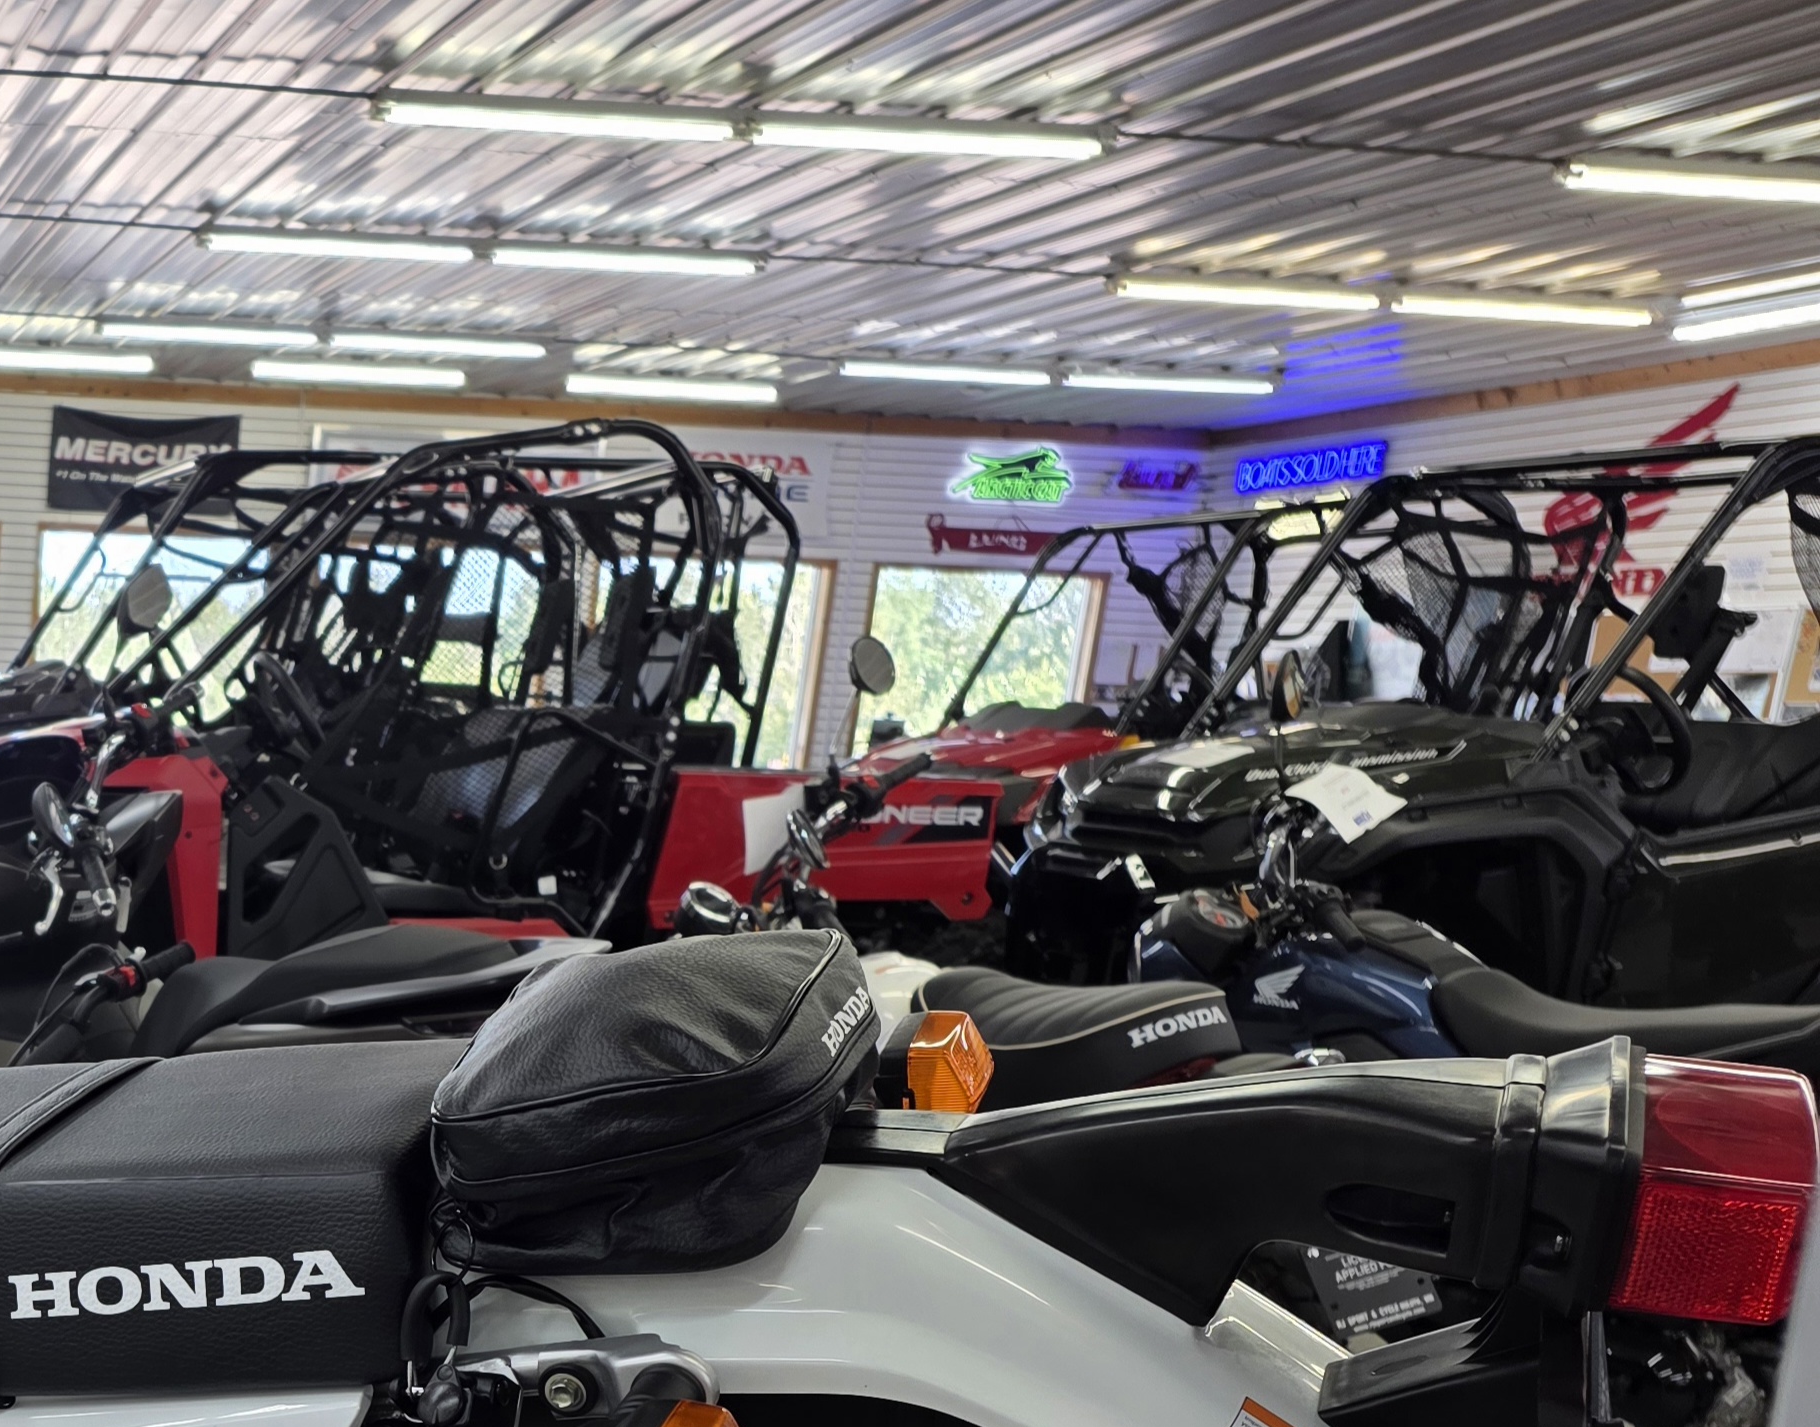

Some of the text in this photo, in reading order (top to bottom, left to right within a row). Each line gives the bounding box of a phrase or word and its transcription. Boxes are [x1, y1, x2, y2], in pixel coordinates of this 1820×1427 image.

[1238, 457, 1291, 491] BOATS
[1290, 450, 1338, 484] SOLD
[1340, 444, 1386, 477] HERE
[973, 477, 1066, 501] ARCTIC CAT
[1244, 768, 1279, 782] Dua
[1253, 993, 1299, 1011] HONDA
[821, 986, 870, 1058] HONDA
[1126, 1005, 1228, 1049] HONDA
[8, 1250, 366, 1319] HONDA
[1333, 1259, 1379, 1284] APPLIED
